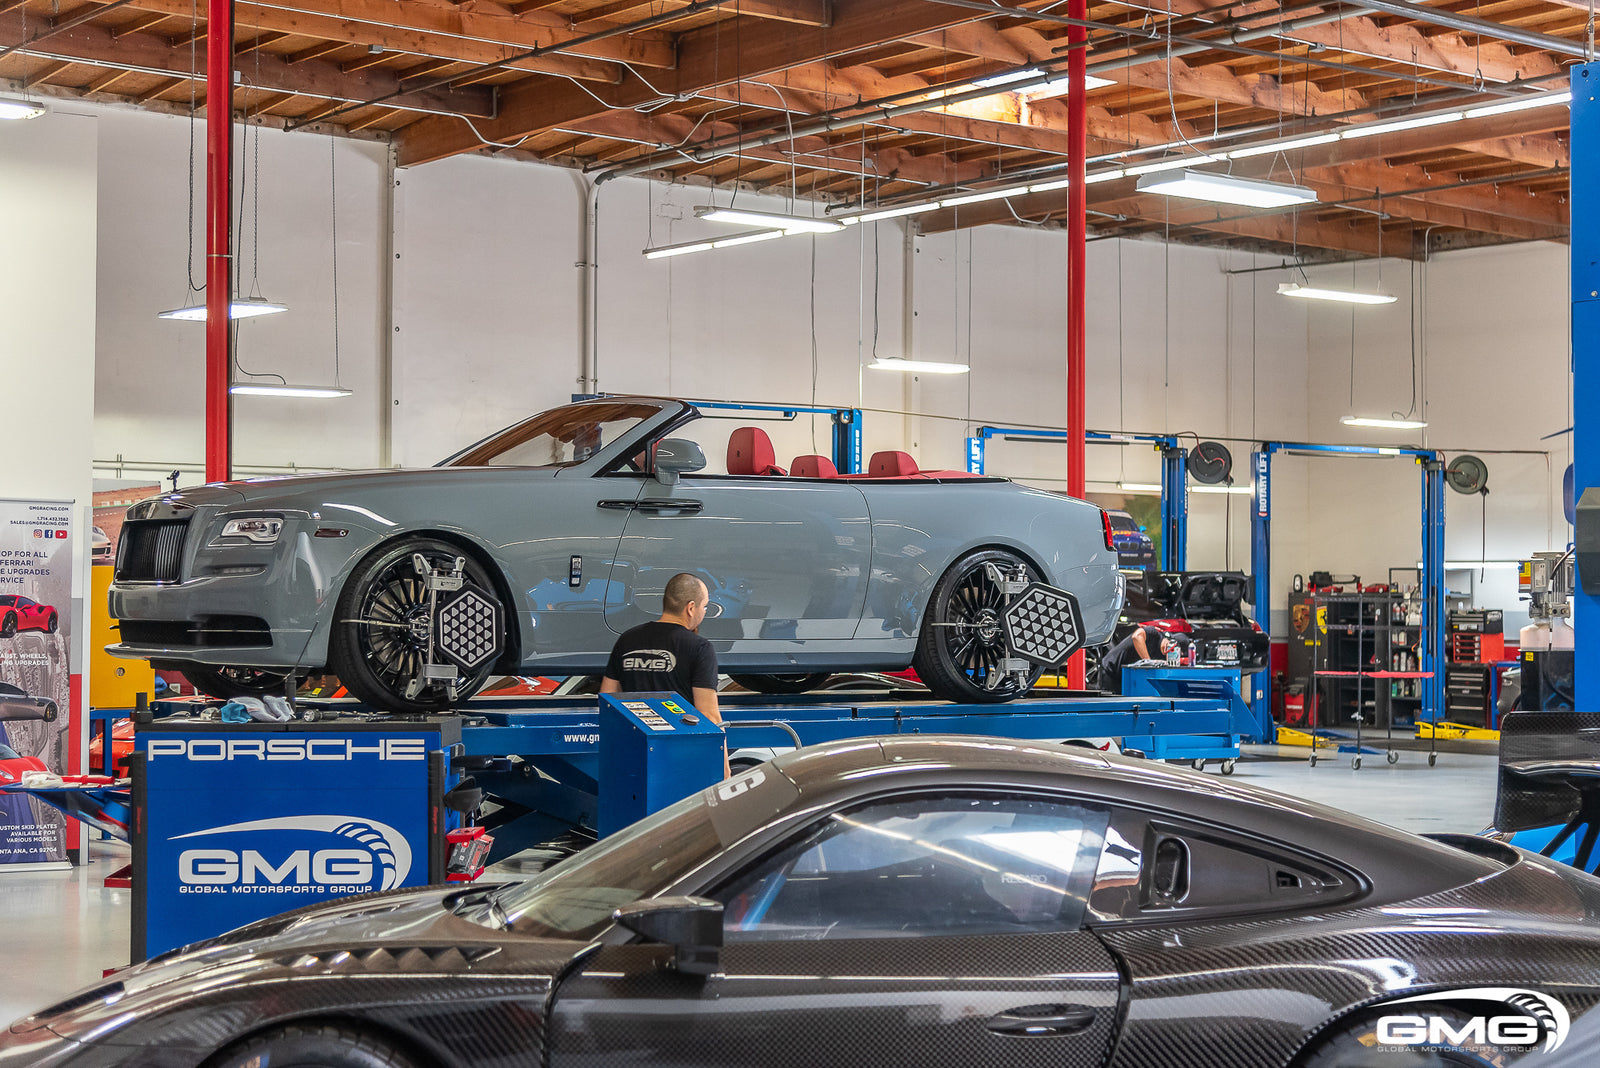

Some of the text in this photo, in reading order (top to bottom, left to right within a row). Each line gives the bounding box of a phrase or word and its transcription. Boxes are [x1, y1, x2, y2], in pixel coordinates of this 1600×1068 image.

[971, 438, 980, 460] LIFT
[1259, 452, 1267, 512] ROTARY LIFT
[623, 657, 667, 669] GMG
[148, 739, 425, 761] PORSCHE
[178, 849, 373, 884] GMG
[179, 885, 372, 894] GLOBAL MOTORSPORTS GROUP
